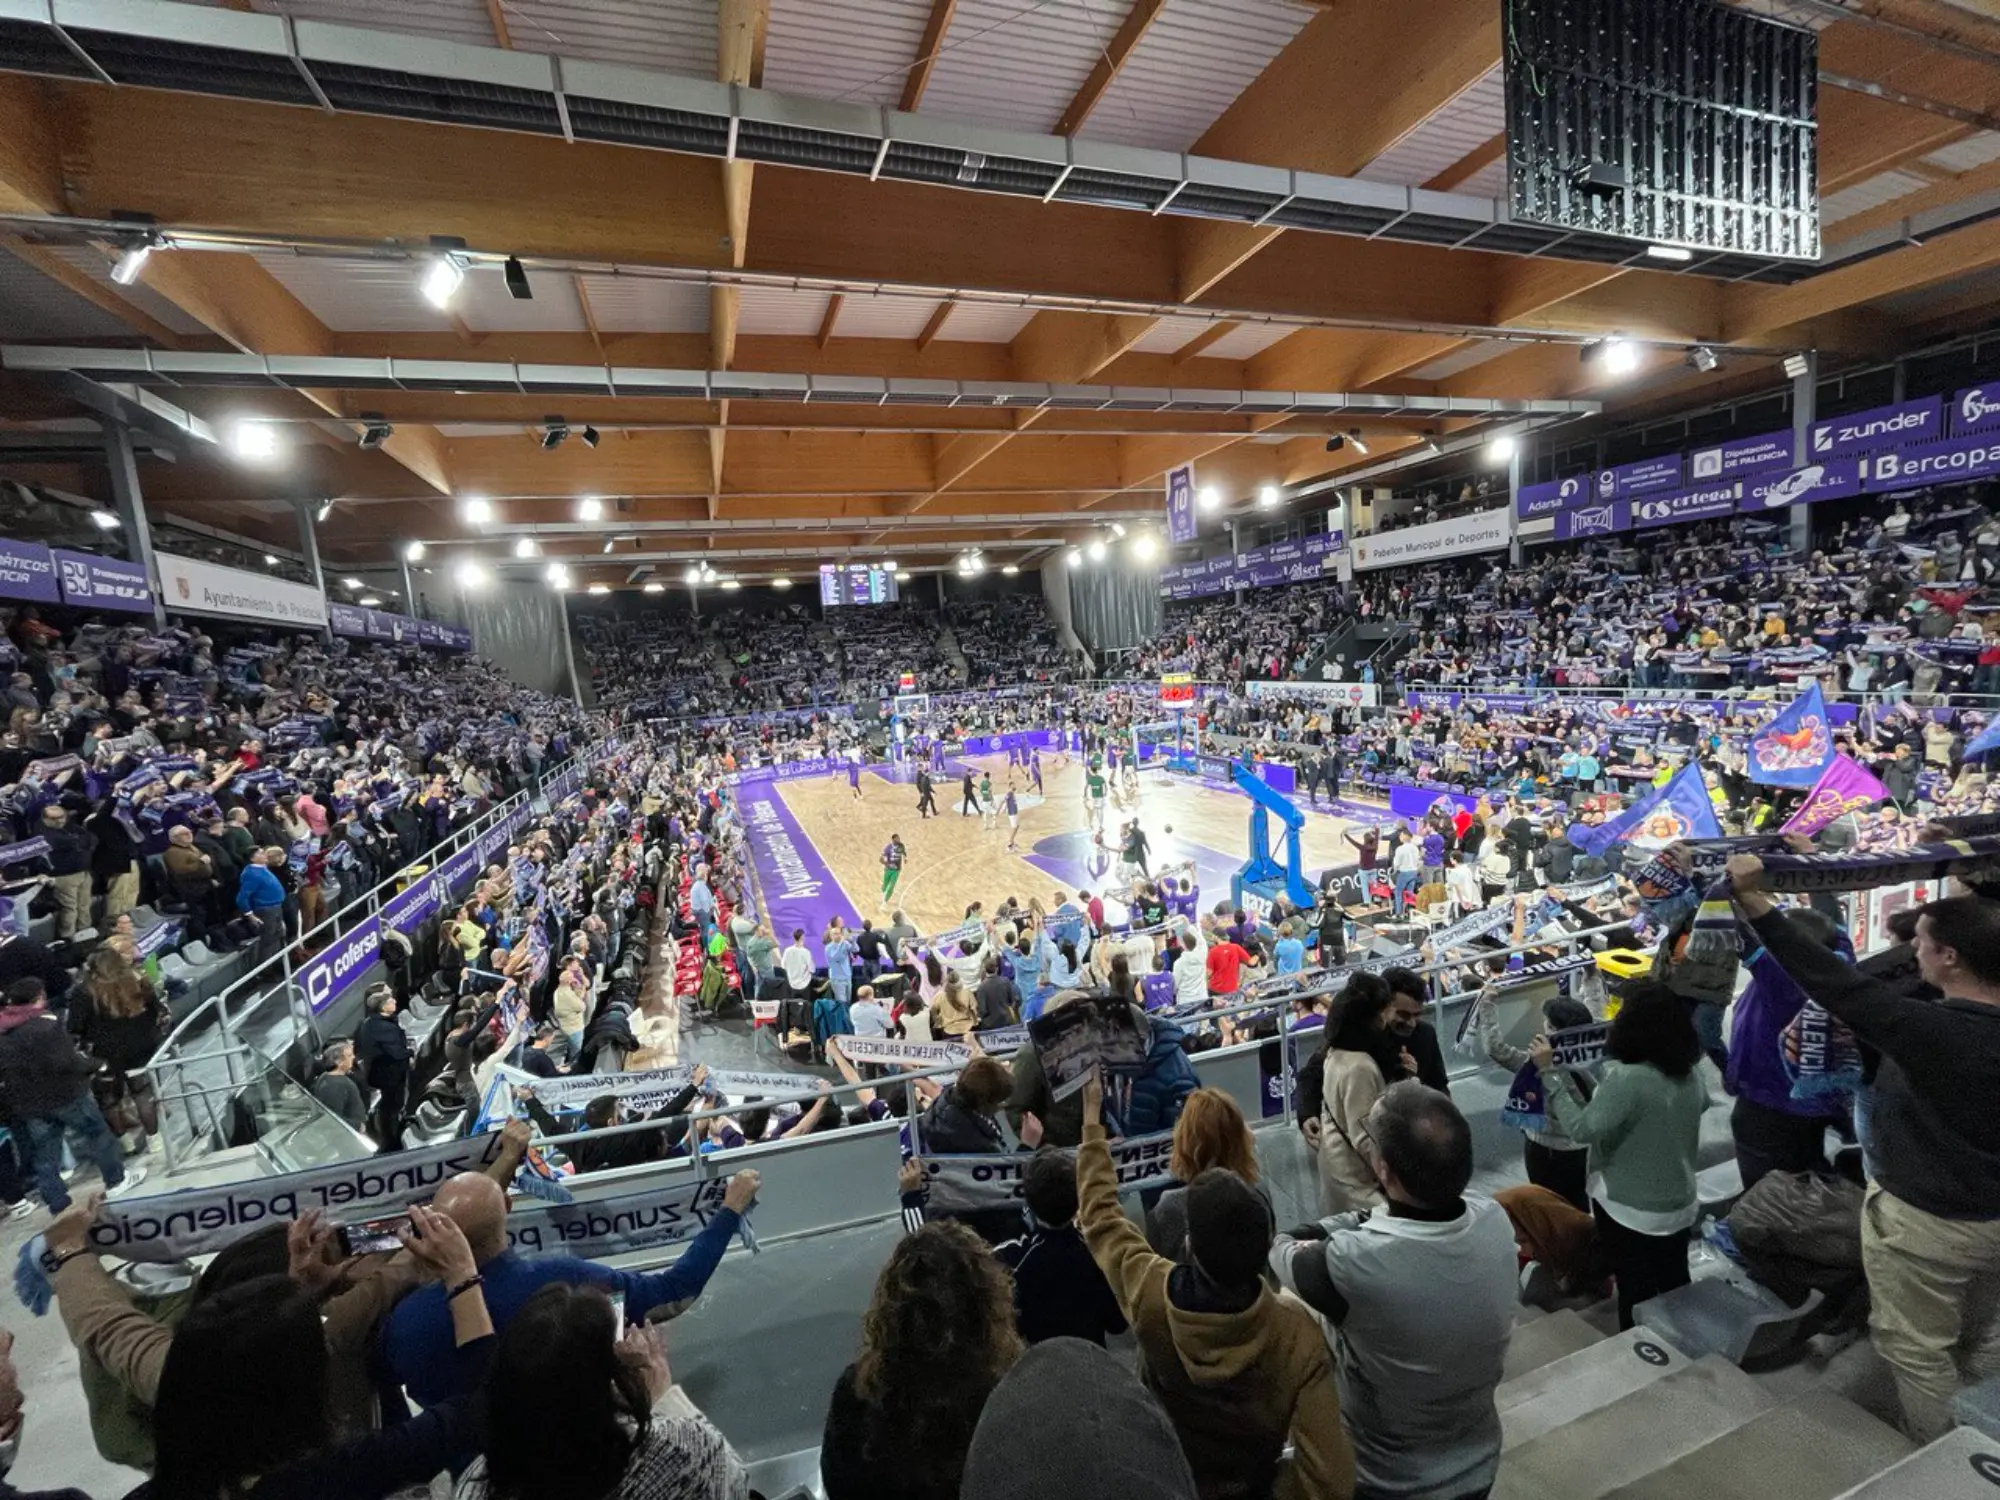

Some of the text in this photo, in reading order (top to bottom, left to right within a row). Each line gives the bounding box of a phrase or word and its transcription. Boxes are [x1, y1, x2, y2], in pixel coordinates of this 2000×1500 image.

[1838, 410, 1931, 442] zunder
[1724, 443, 1776, 459] Diputación
[1724, 450, 1788, 468] DE PALENCIA
[1528, 498, 1563, 512] Adarsa
[1673, 489, 1732, 507] ortega
[1444, 536, 1455, 546] de
[1459, 528, 1500, 544] Deportes
[204, 587, 275, 612] Ayuntamiento
[334, 930, 378, 978] cofersa
